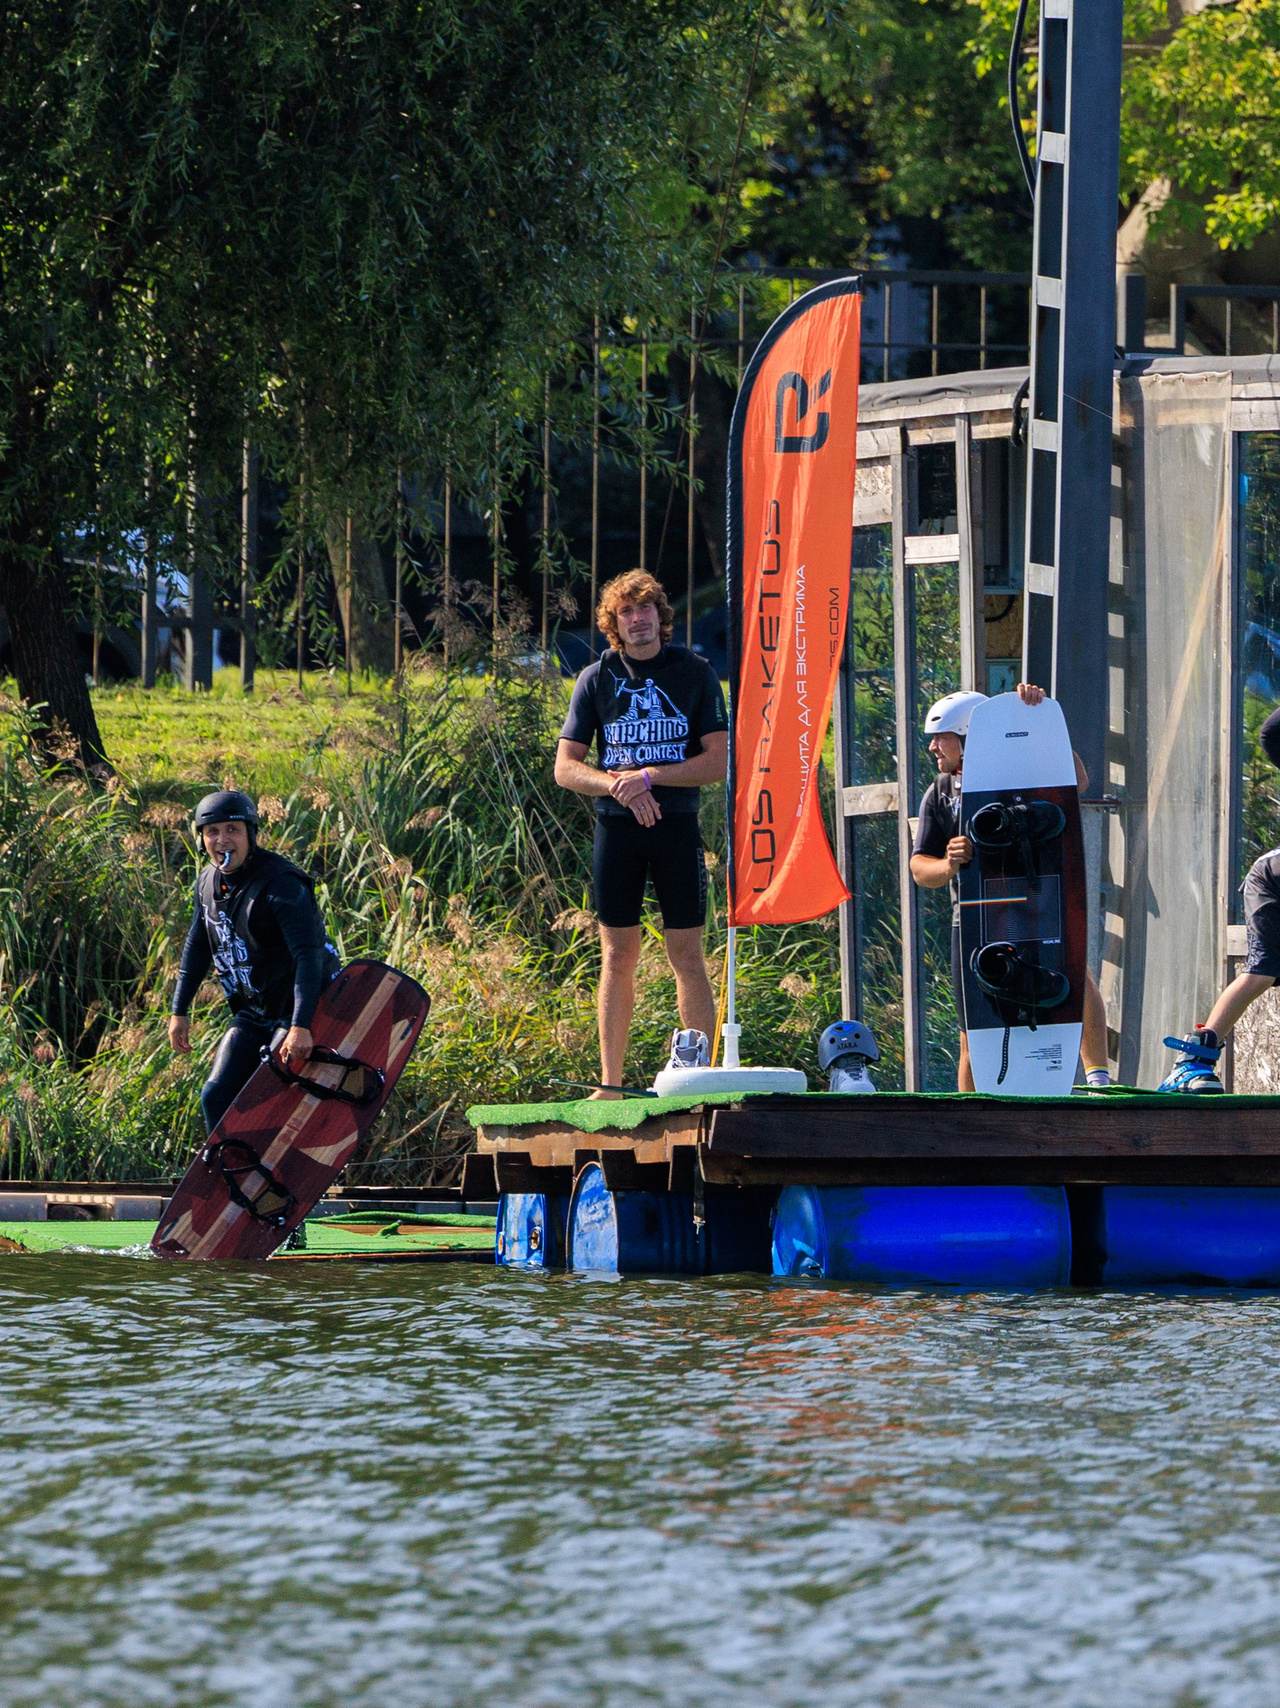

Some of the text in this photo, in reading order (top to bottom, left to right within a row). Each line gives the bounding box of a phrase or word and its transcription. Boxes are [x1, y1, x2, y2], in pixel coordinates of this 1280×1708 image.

[795, 564, 807, 676] ЭКСТРИМА
[796, 678, 812, 727] ДЛЯ
[603, 742, 688, 767] OPEN CONTEST
[752, 789, 776, 893] LOS
